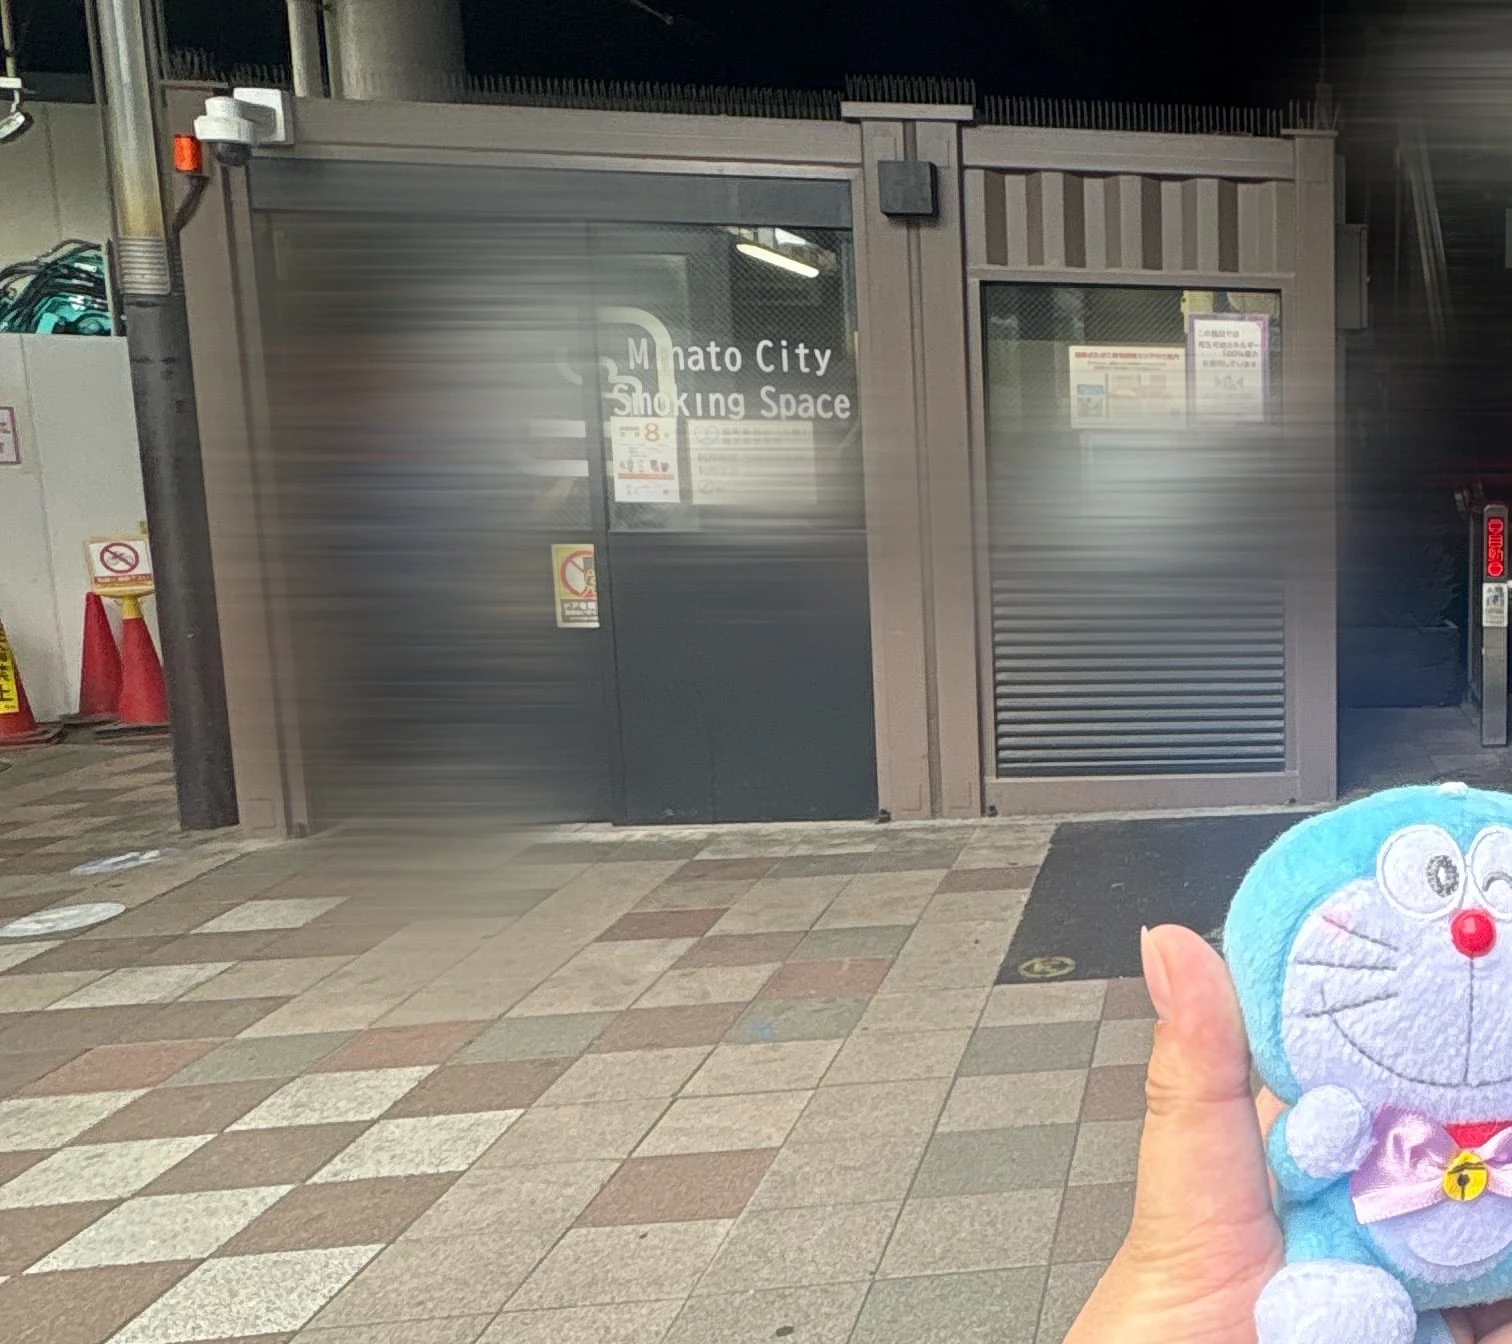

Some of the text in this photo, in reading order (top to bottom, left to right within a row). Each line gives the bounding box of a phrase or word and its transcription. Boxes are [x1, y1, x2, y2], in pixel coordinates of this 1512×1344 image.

[756, 339, 832, 377] City
[612, 383, 851, 420] Smoking Space
